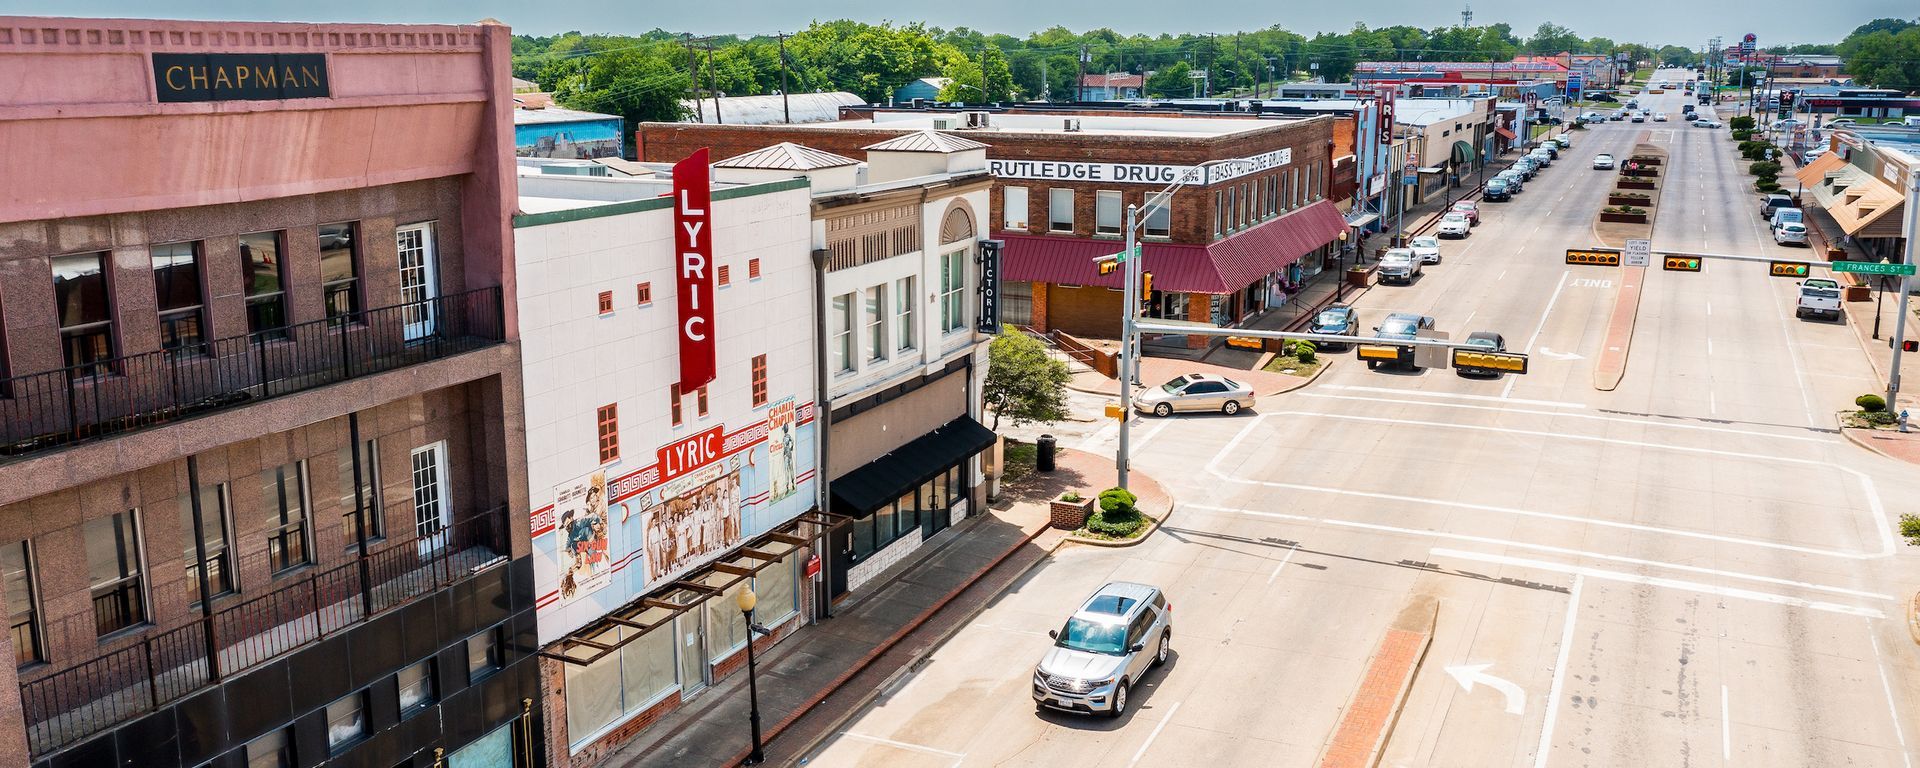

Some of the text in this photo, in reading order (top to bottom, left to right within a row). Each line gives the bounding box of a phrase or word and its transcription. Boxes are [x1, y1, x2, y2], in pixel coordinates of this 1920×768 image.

[165, 64, 319, 91] CHAPMAN
[1382, 91, 1392, 142] IRIS
[990, 161, 1174, 182] RUTLEDGE DRUG
[681, 189, 706, 341] LYRIC
[1846, 263, 1886, 273] FRANCES
[1569, 278, 1612, 289] ONLY
[768, 401, 794, 420] CHARLIE
[666, 433, 716, 477] LYRIC
